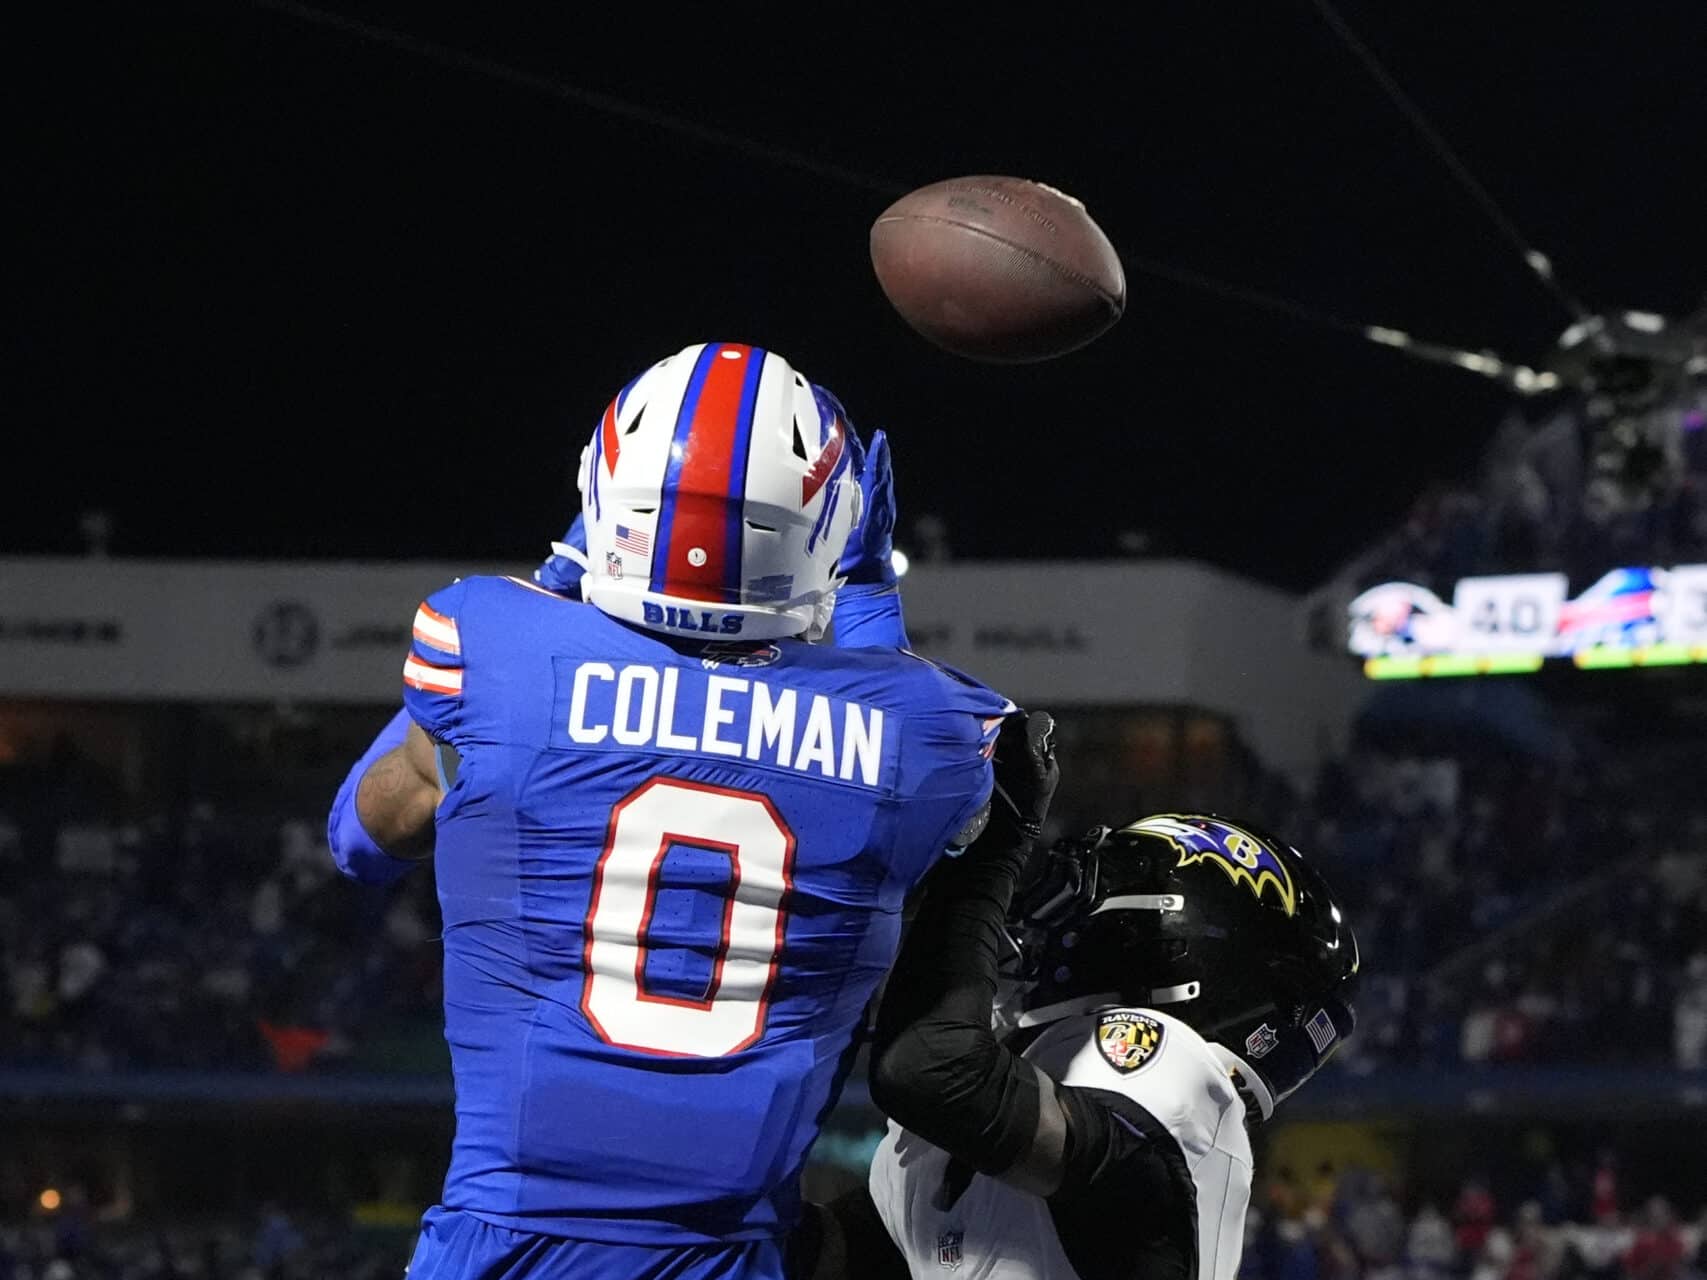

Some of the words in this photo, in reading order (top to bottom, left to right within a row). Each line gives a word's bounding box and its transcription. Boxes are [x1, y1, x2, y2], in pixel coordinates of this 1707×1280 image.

[643, 601, 744, 634] BILLS
[1473, 596, 1541, 634] 40
[568, 662, 883, 786] COLEMAN
[1223, 834, 1262, 869] B
[580, 775, 797, 1058] 0
[1102, 1013, 1158, 1027] RAVENS
[1247, 1032, 1269, 1054] NFL
[941, 1246, 961, 1263] NFL
